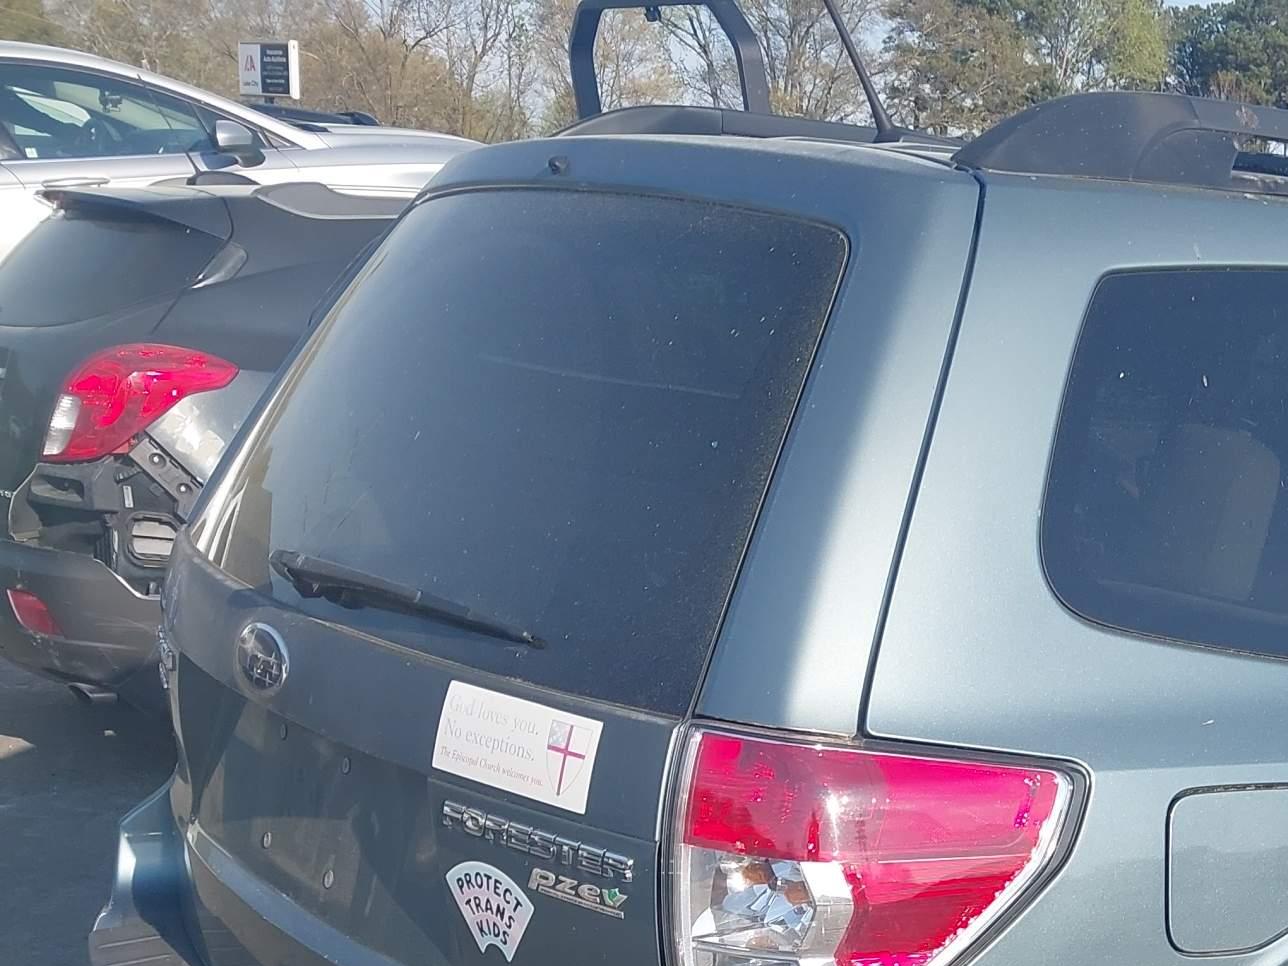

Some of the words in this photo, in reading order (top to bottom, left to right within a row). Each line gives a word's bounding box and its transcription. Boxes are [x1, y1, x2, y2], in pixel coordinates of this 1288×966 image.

[477, 701, 508, 727] loves
[444, 718, 462, 738] No
[465, 731, 535, 761] exceptions.
[479, 758, 501, 774] Church
[442, 800, 634, 883] FORESTER
[456, 872, 523, 913] PROTECT
[465, 896, 515, 930] TRANS
[476, 919, 510, 946] KIDS
